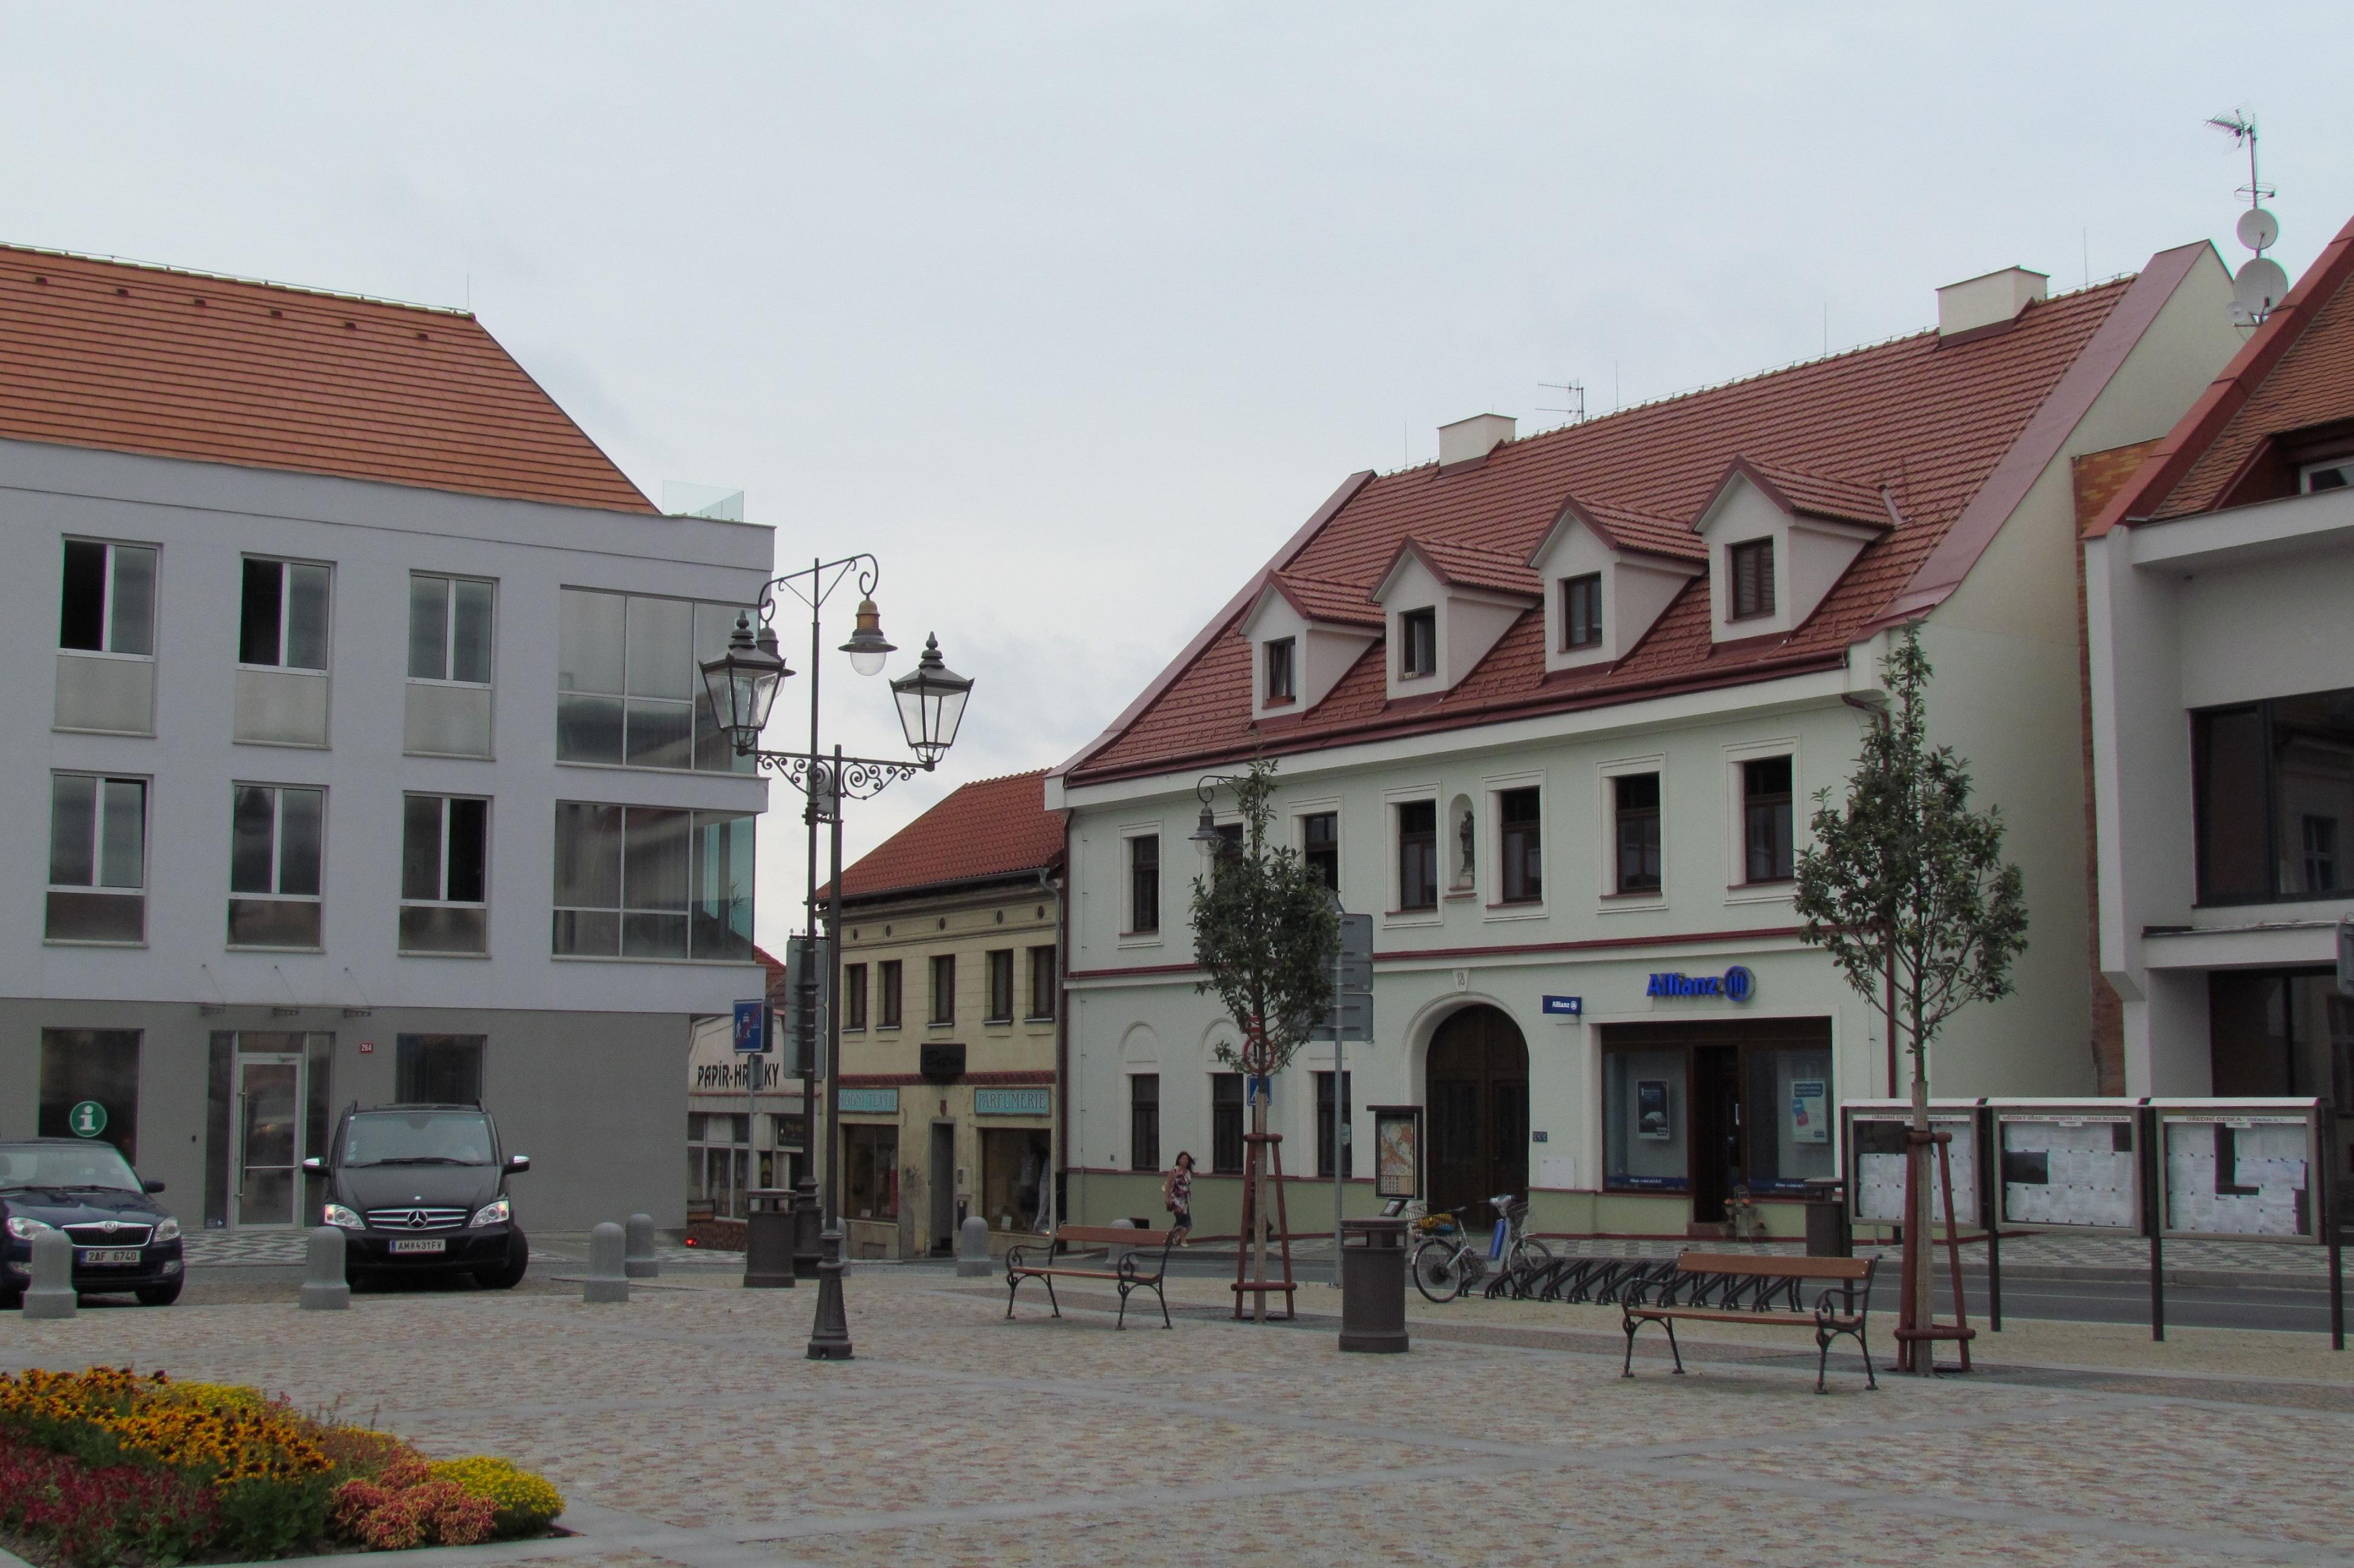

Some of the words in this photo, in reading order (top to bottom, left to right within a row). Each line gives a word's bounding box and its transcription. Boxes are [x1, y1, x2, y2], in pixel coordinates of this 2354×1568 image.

[1457, 972, 1465, 986] 18
[1647, 973, 1718, 996] Allianz
[697, 1059, 779, 1089] PAPÍR-HRKY
[868, 1093, 897, 1107] TEXTIL
[978, 1093, 1046, 1109] PARFUMERIE
[88, 1251, 107, 1262] 2AF
[113, 1251, 137, 1261] 6740
